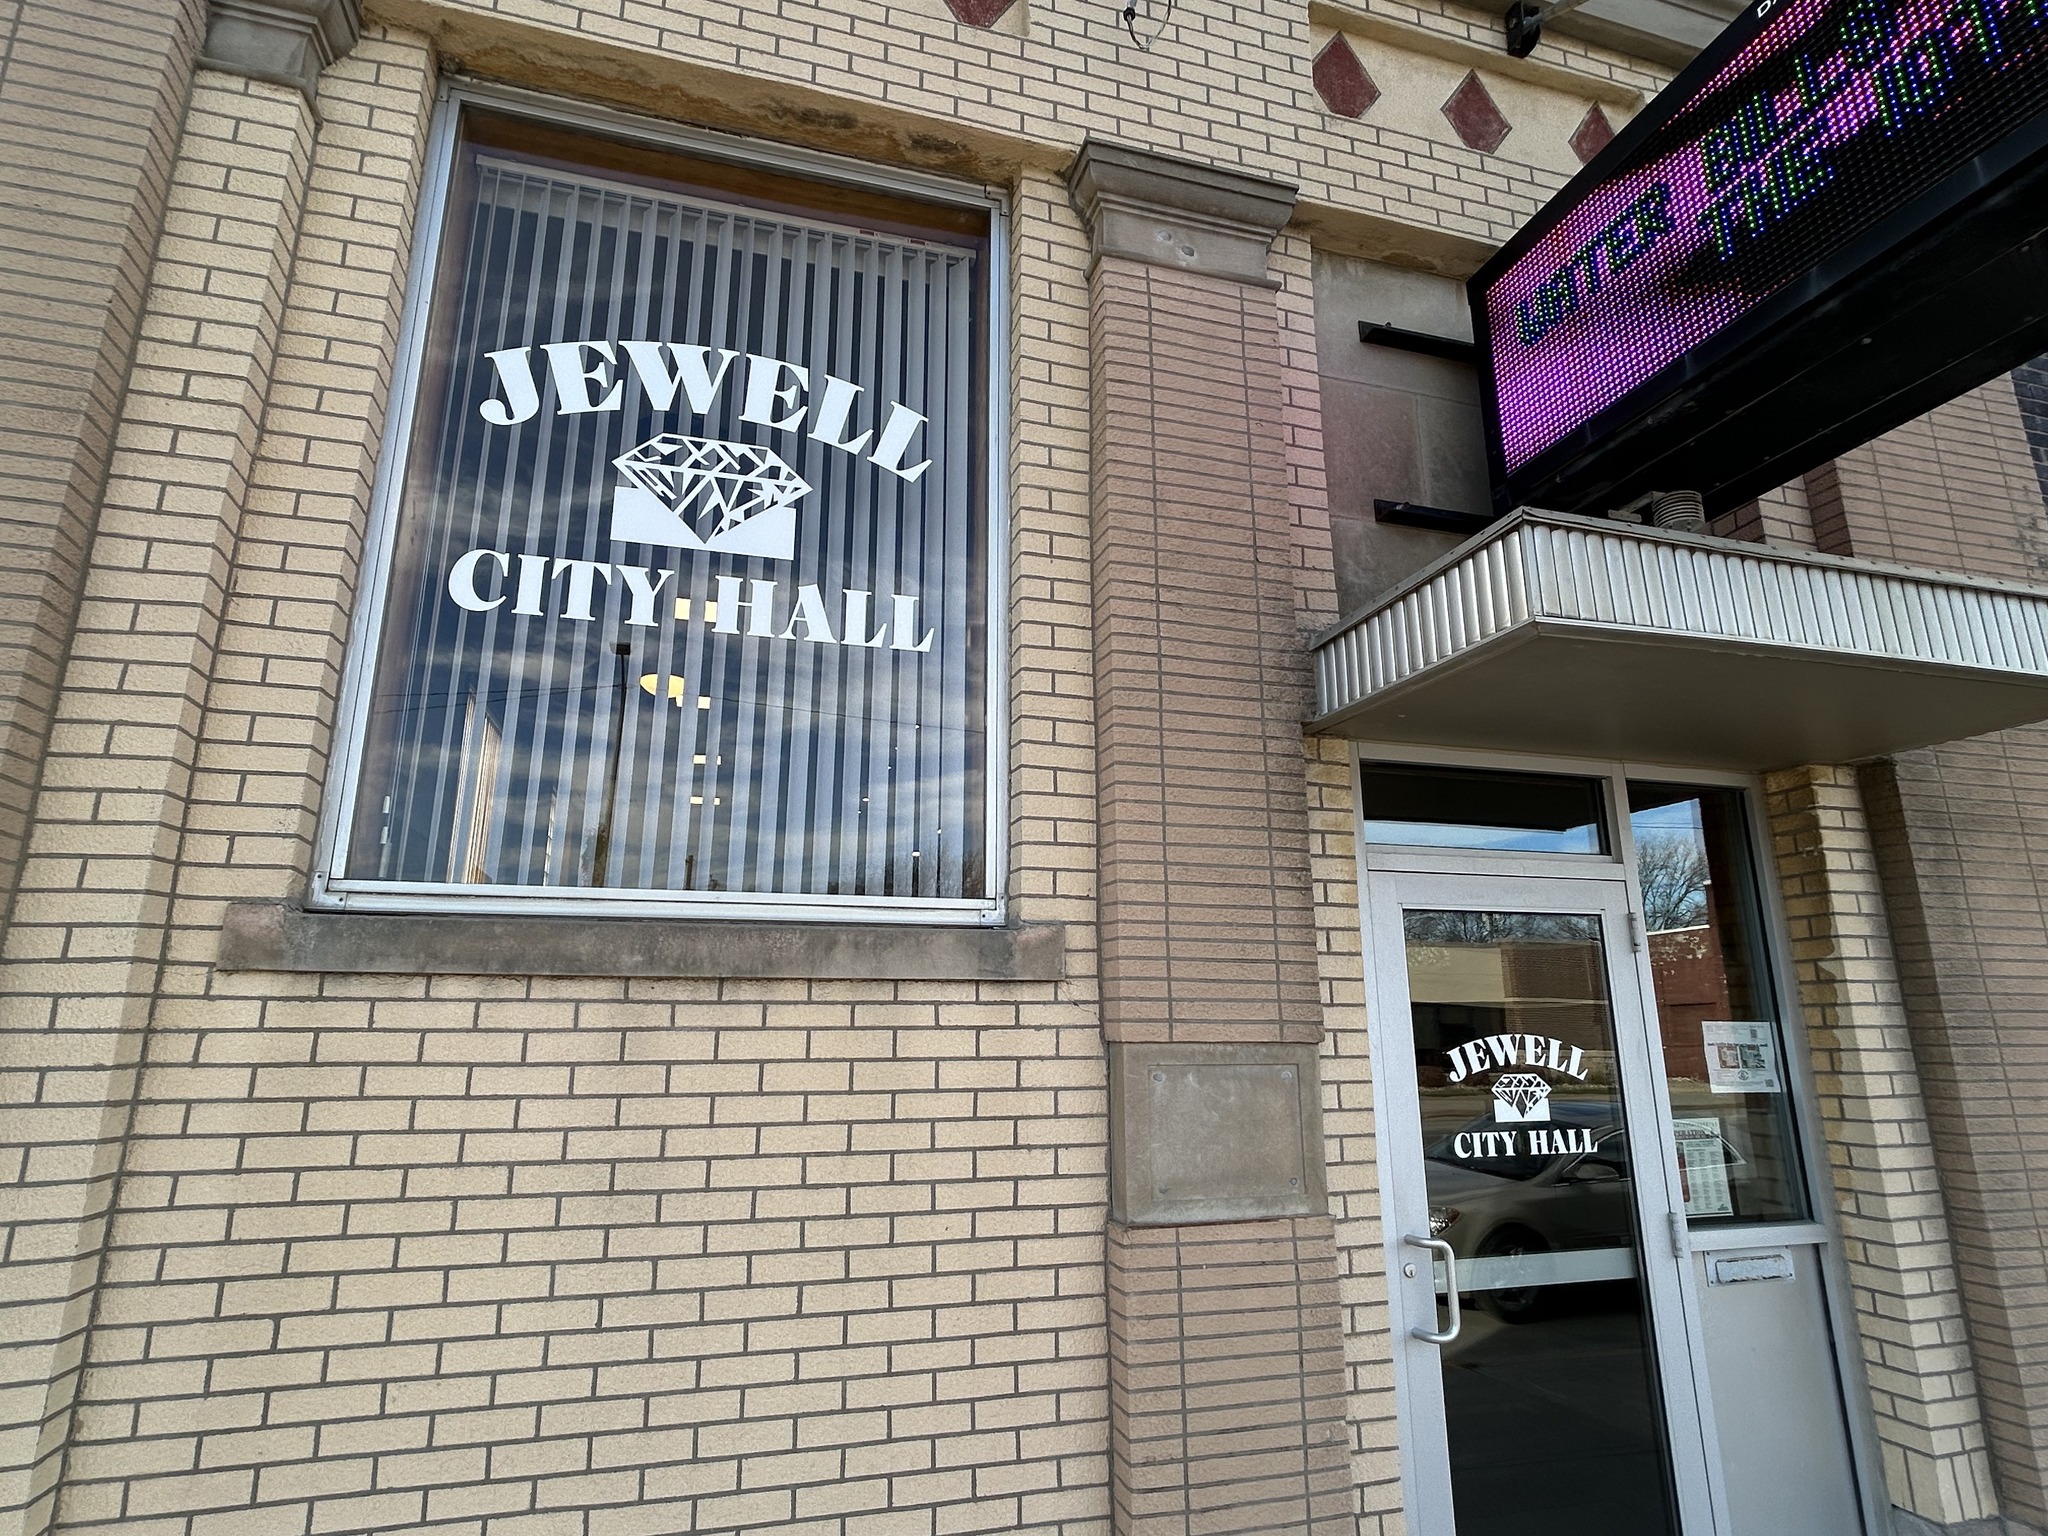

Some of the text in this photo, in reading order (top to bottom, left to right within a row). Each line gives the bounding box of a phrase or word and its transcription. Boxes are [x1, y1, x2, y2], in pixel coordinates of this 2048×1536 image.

[1697, 0, 2048, 260] THE 10T
[1515, 183, 1674, 347] WATER
[479, 340, 933, 483] JEWELL
[448, 549, 935, 653] CITY HALL
[1446, 1034, 1589, 1082] JEWELL
[1454, 1129, 1598, 1159] CITY HALL
